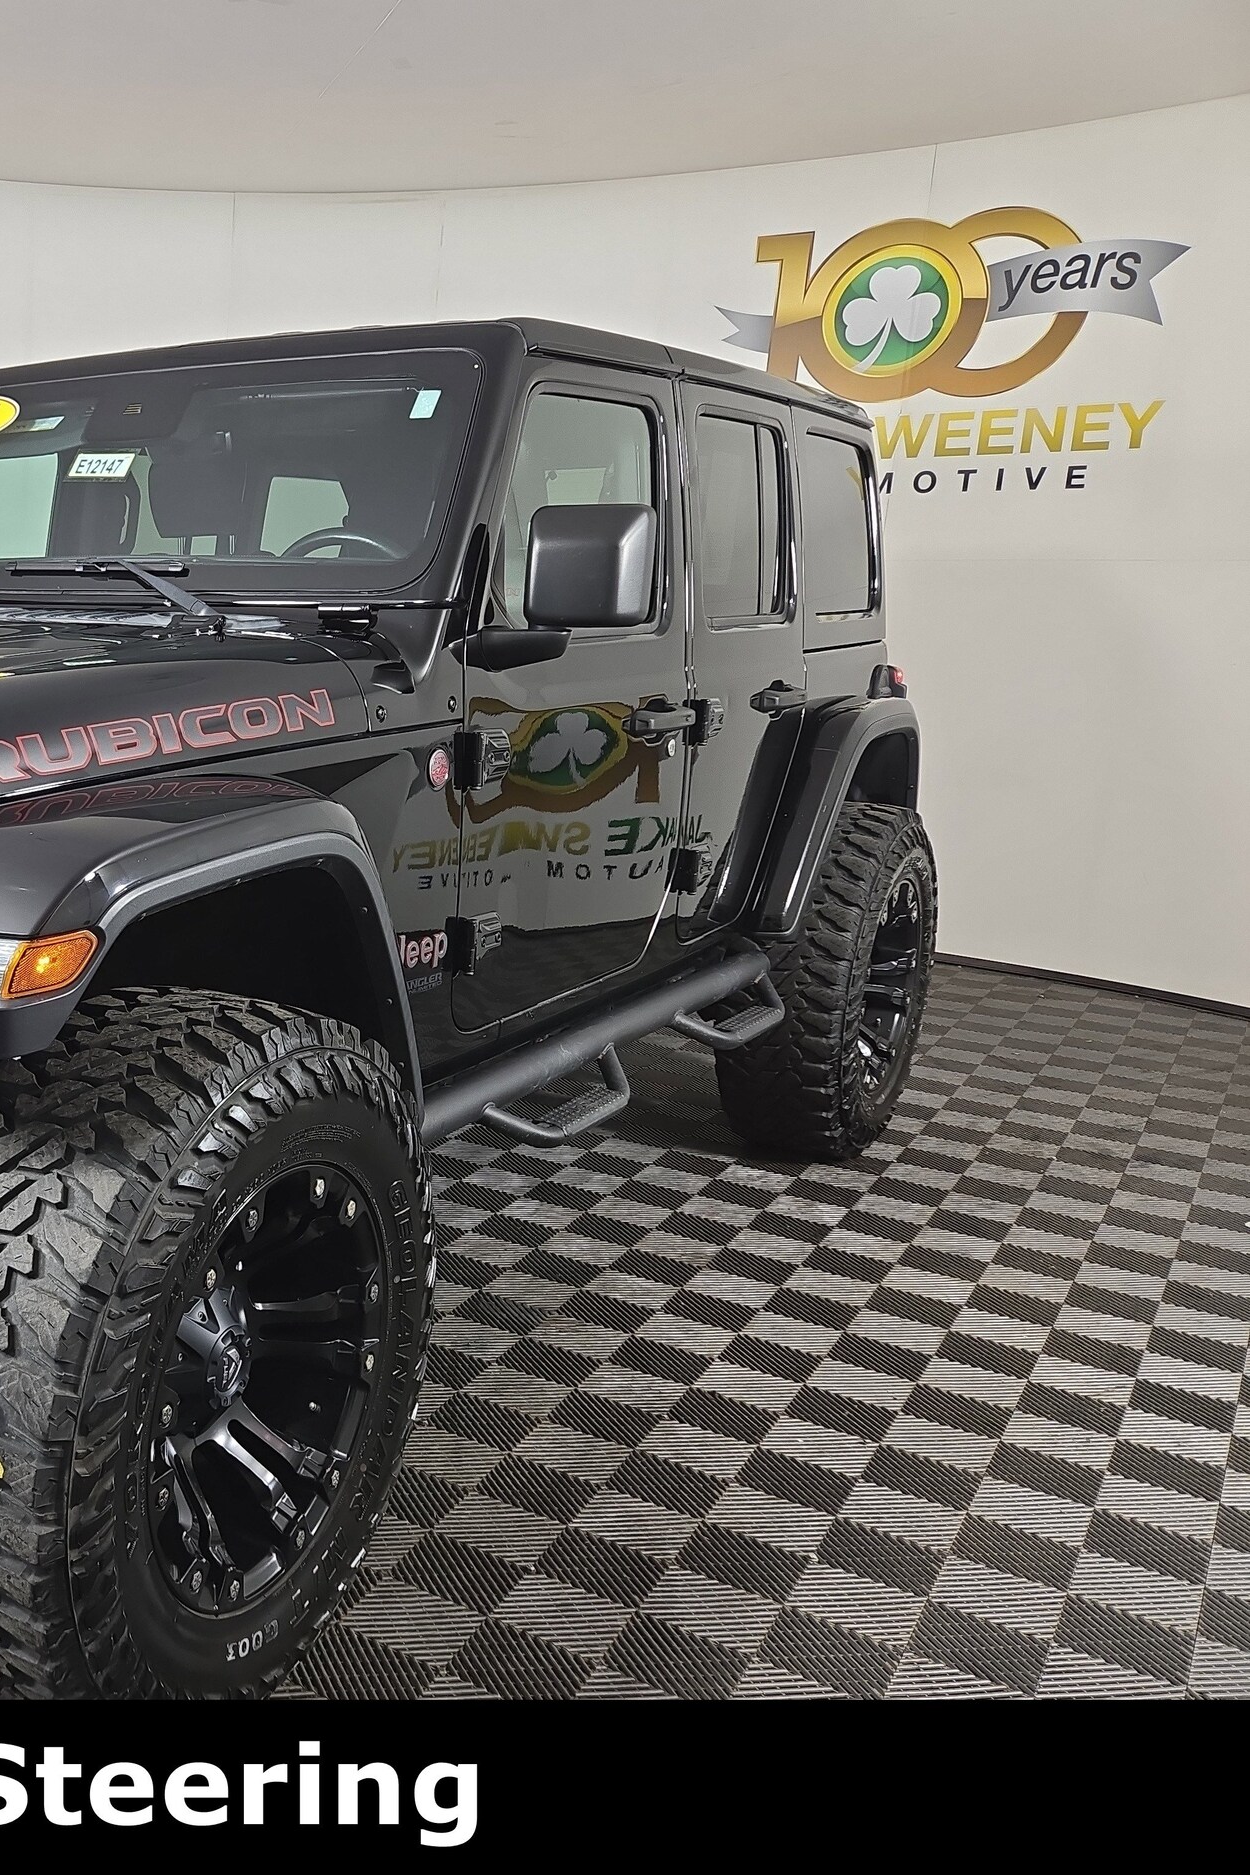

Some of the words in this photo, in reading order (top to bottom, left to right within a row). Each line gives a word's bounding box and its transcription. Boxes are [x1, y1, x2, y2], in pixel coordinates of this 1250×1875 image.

[998, 251, 1142, 312] years
[875, 400, 1166, 459] WEENEY
[75, 459, 125, 474] E12147
[879, 465, 1088, 494] MOTIVE
